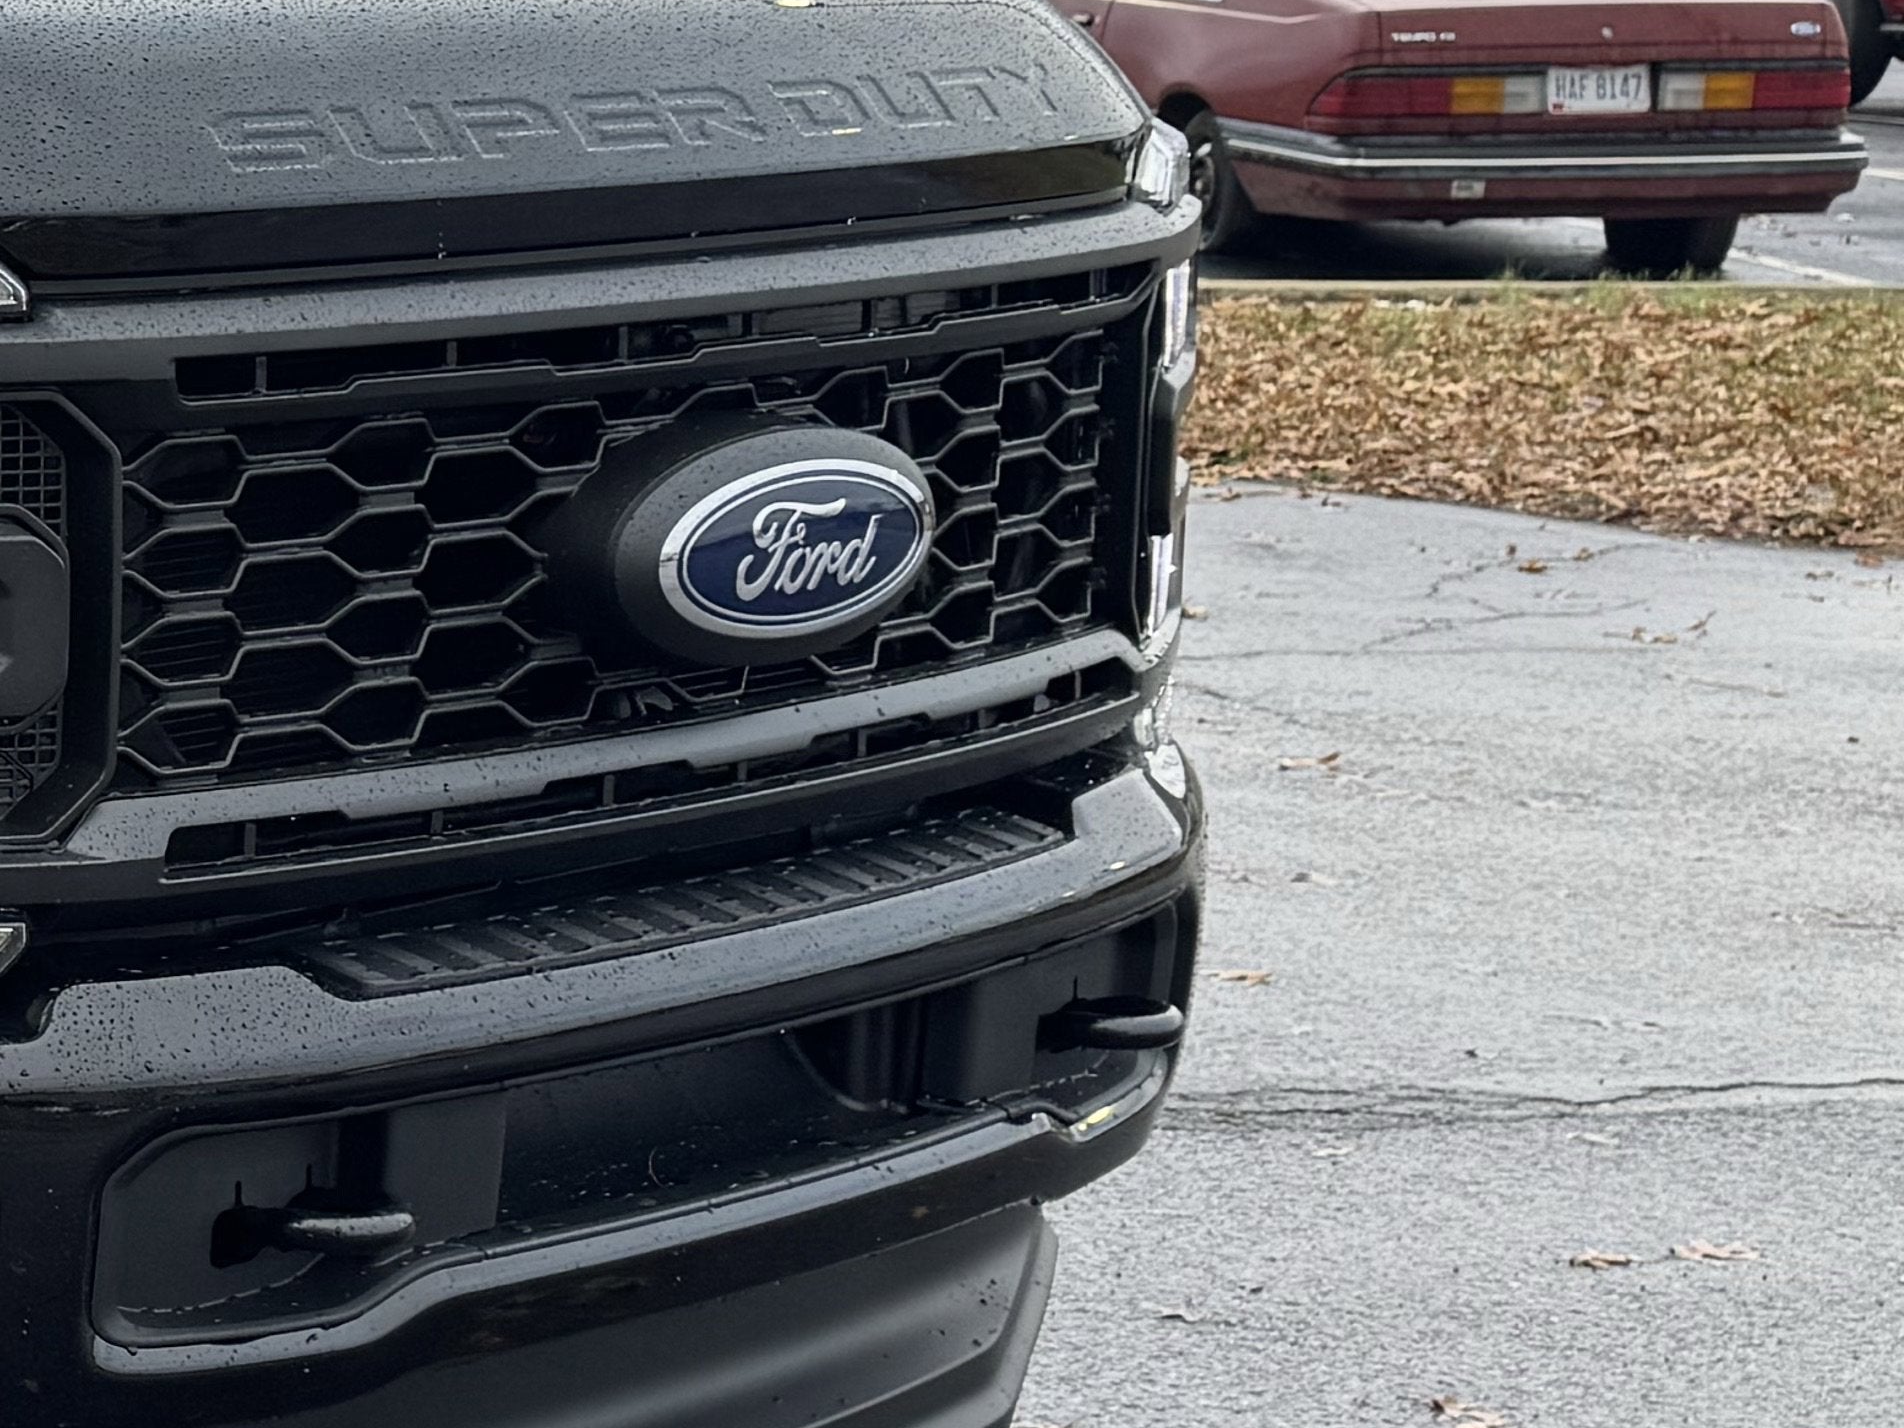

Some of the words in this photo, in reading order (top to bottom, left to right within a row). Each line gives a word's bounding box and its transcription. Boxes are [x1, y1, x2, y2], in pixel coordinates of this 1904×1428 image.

[203, 88, 768, 172] SUPER
[765, 61, 1058, 138] DUTY
[735, 497, 885, 602] Ford
